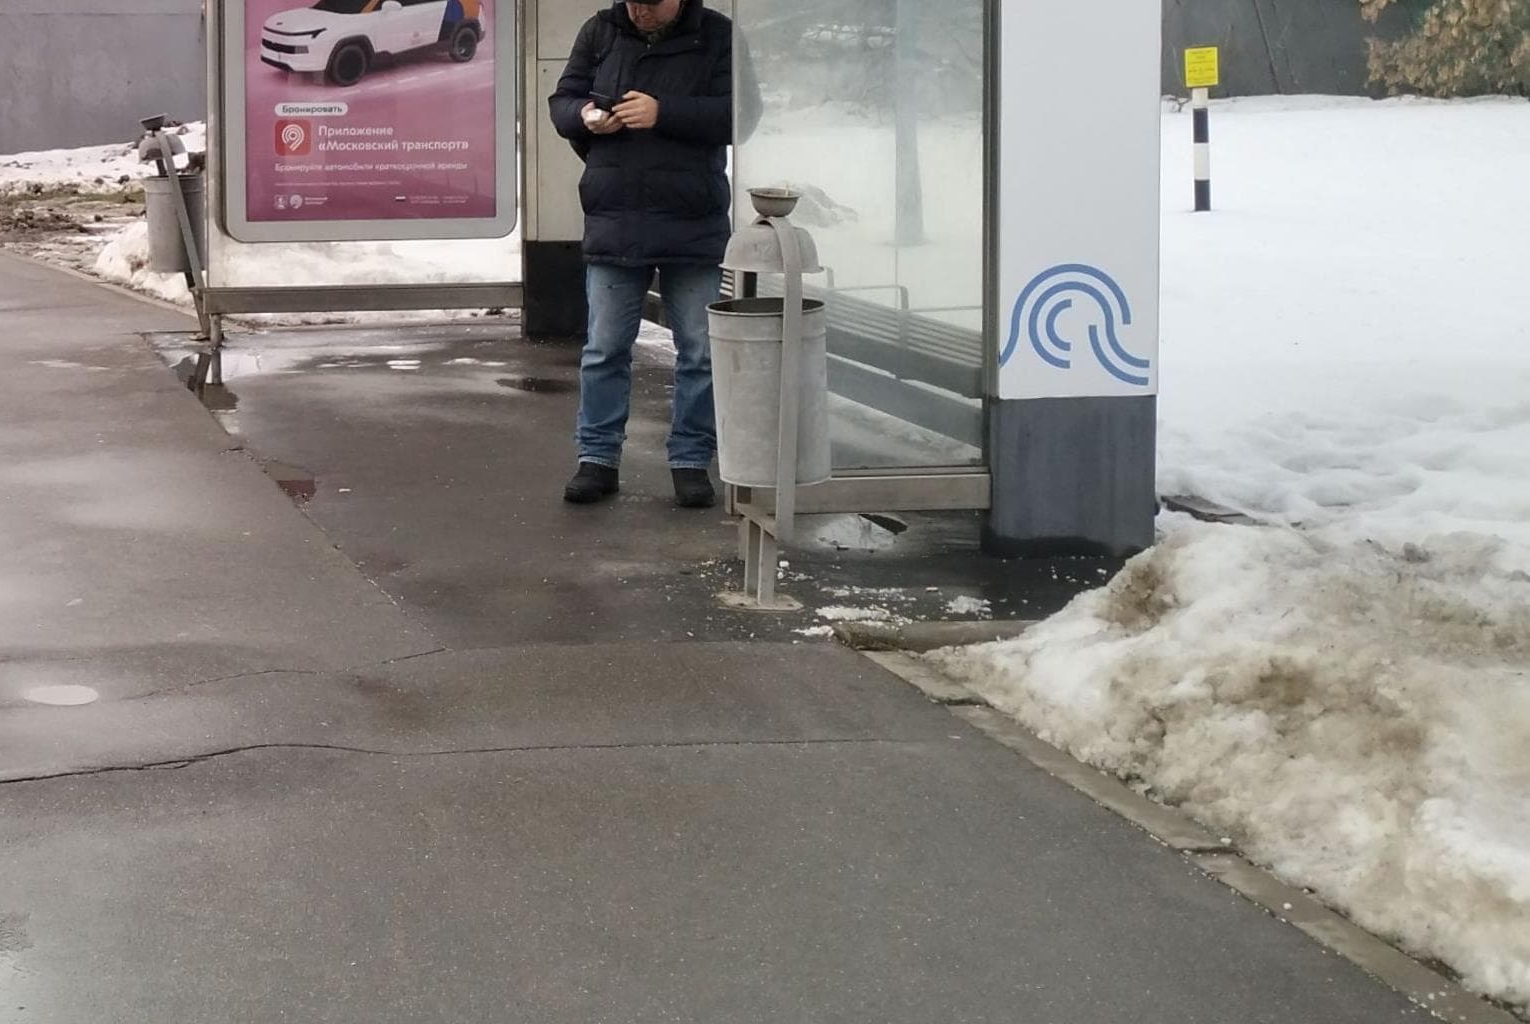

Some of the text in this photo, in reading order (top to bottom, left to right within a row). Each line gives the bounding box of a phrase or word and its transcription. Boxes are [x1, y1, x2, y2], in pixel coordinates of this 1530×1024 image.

[282, 105, 343, 114] Бронировать
[318, 125, 394, 137] Приложение
[318, 139, 469, 152] «Московский транспорт»
